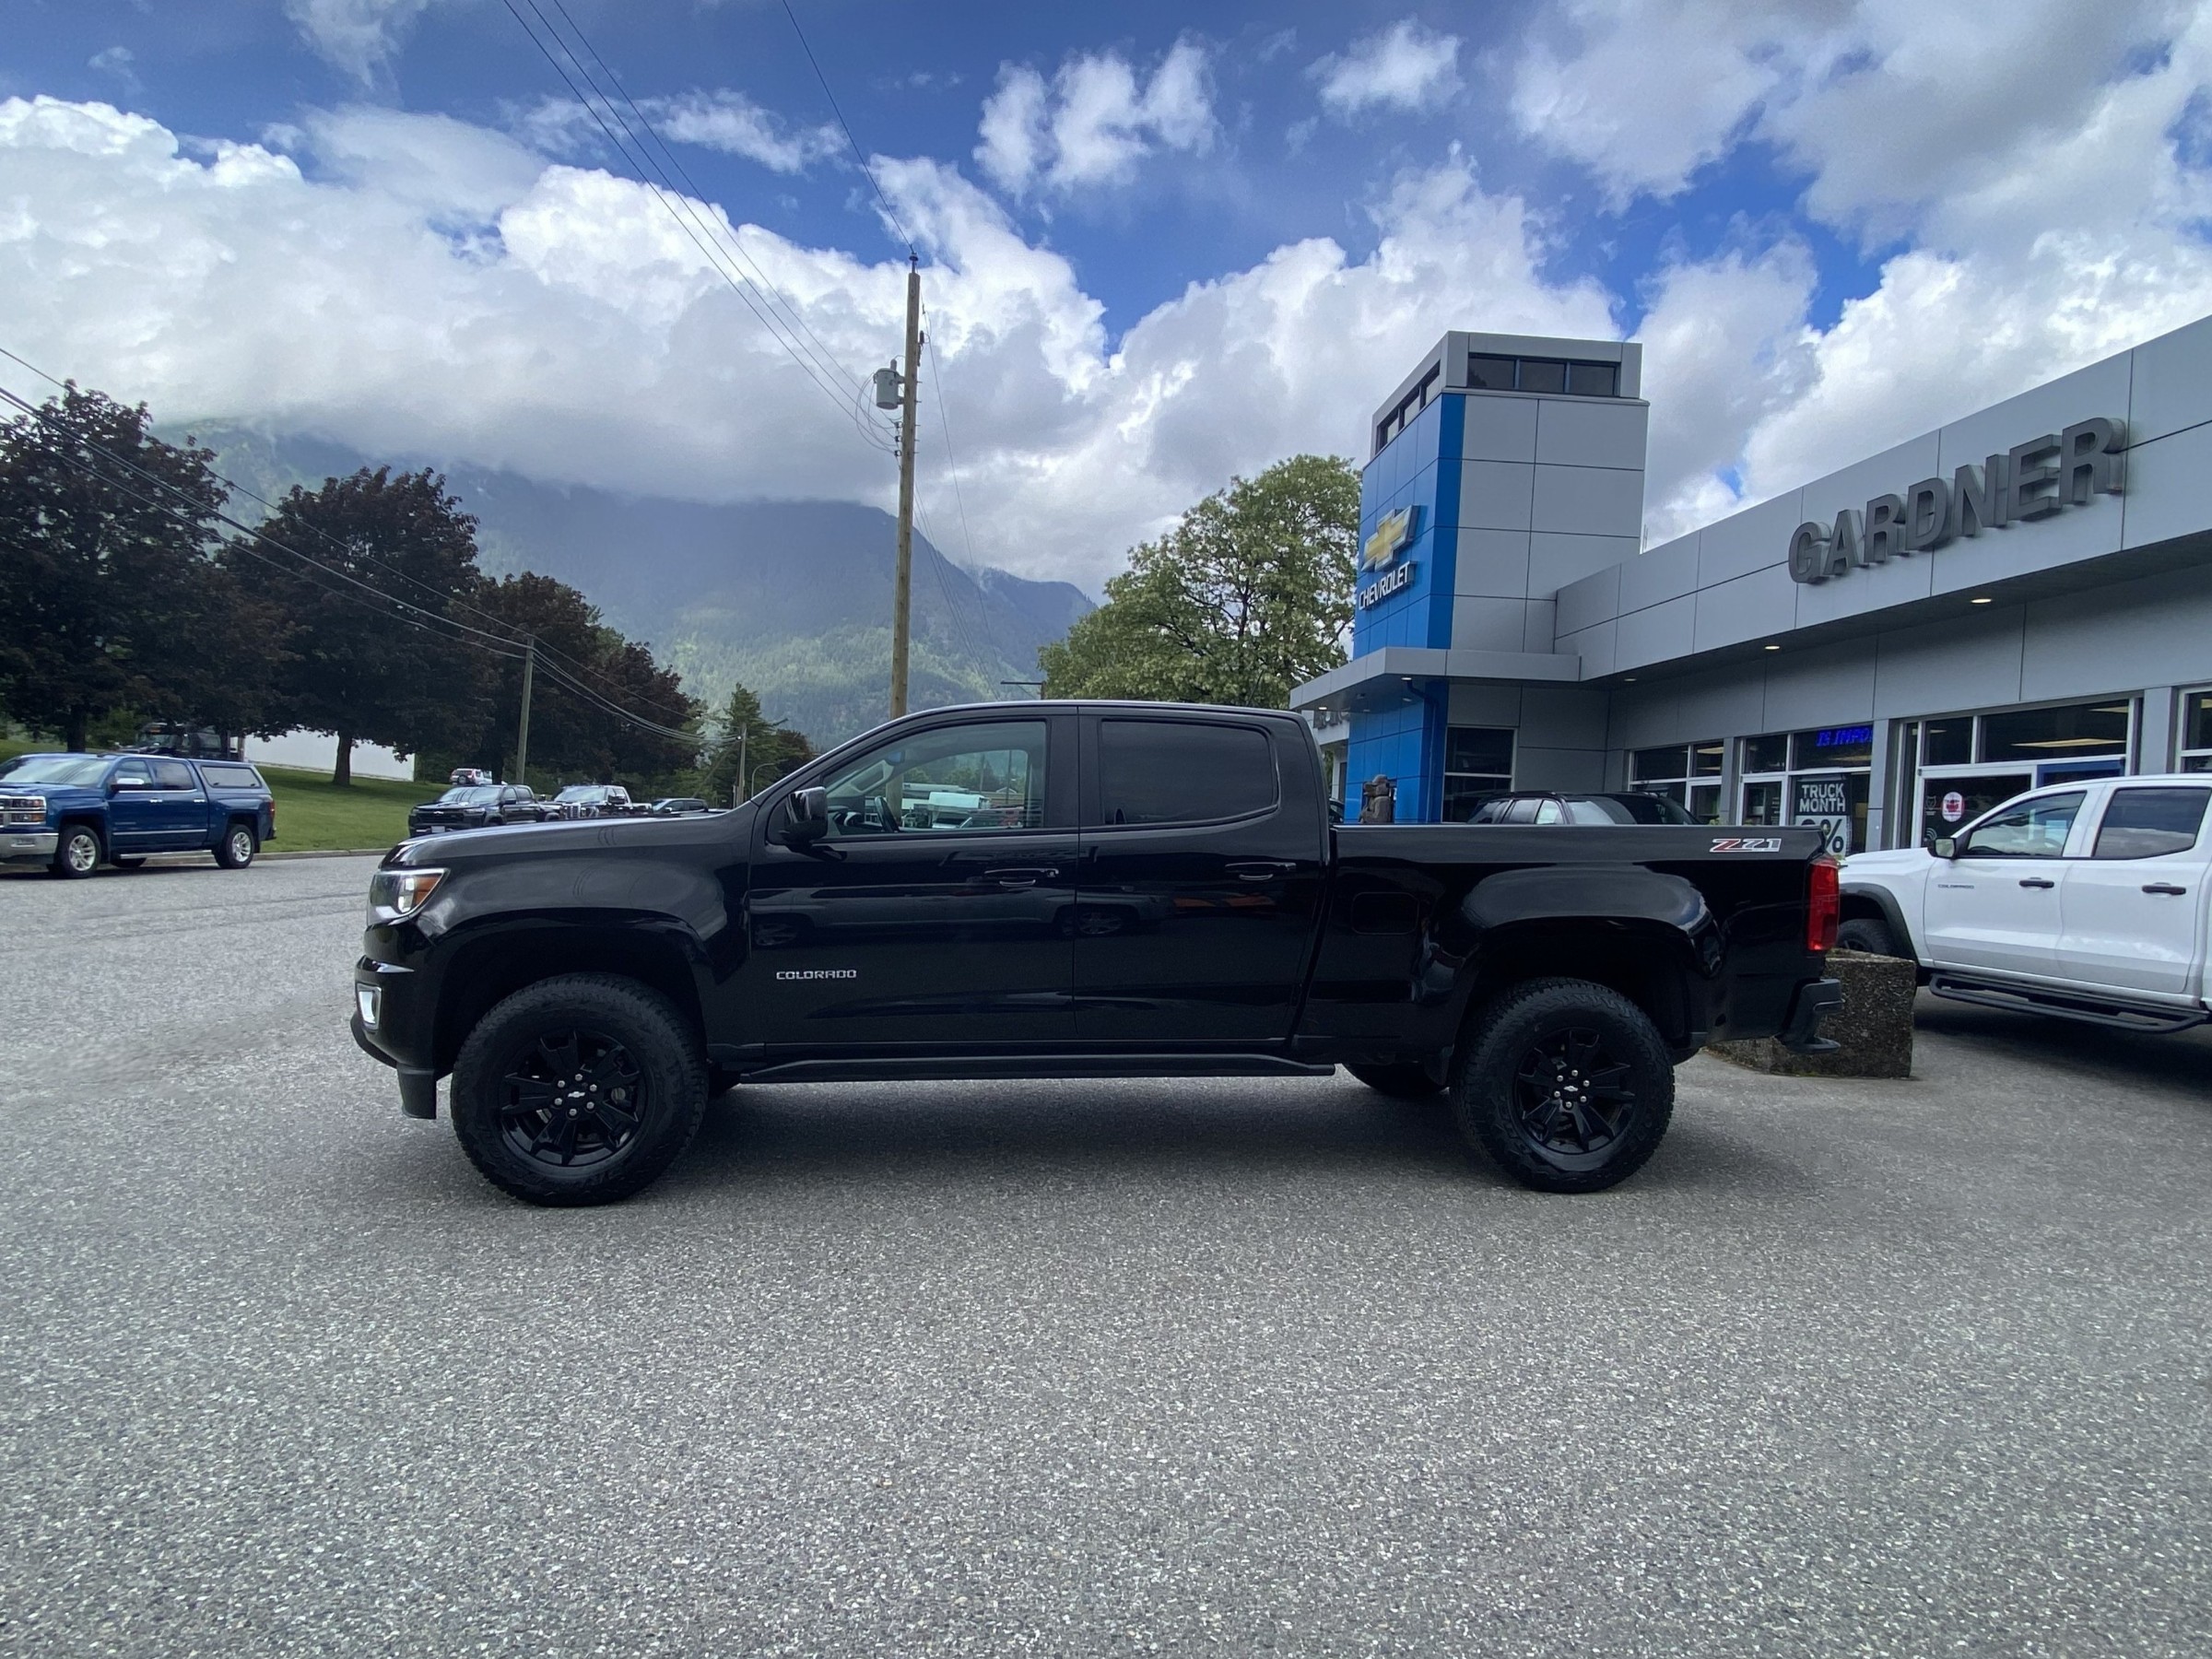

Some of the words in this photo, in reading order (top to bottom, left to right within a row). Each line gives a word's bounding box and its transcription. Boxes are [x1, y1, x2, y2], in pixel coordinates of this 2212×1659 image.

[1788, 417, 2125, 583] GARDNER
[1359, 560, 1410, 610] CHEVROLET
[1833, 727, 1873, 746] IMPO
[1801, 783, 1844, 799] TRUCK
[1799, 797, 1845, 813] MONTH
[1709, 838, 1783, 853] Z71
[776, 969, 857, 980] COLORADO
